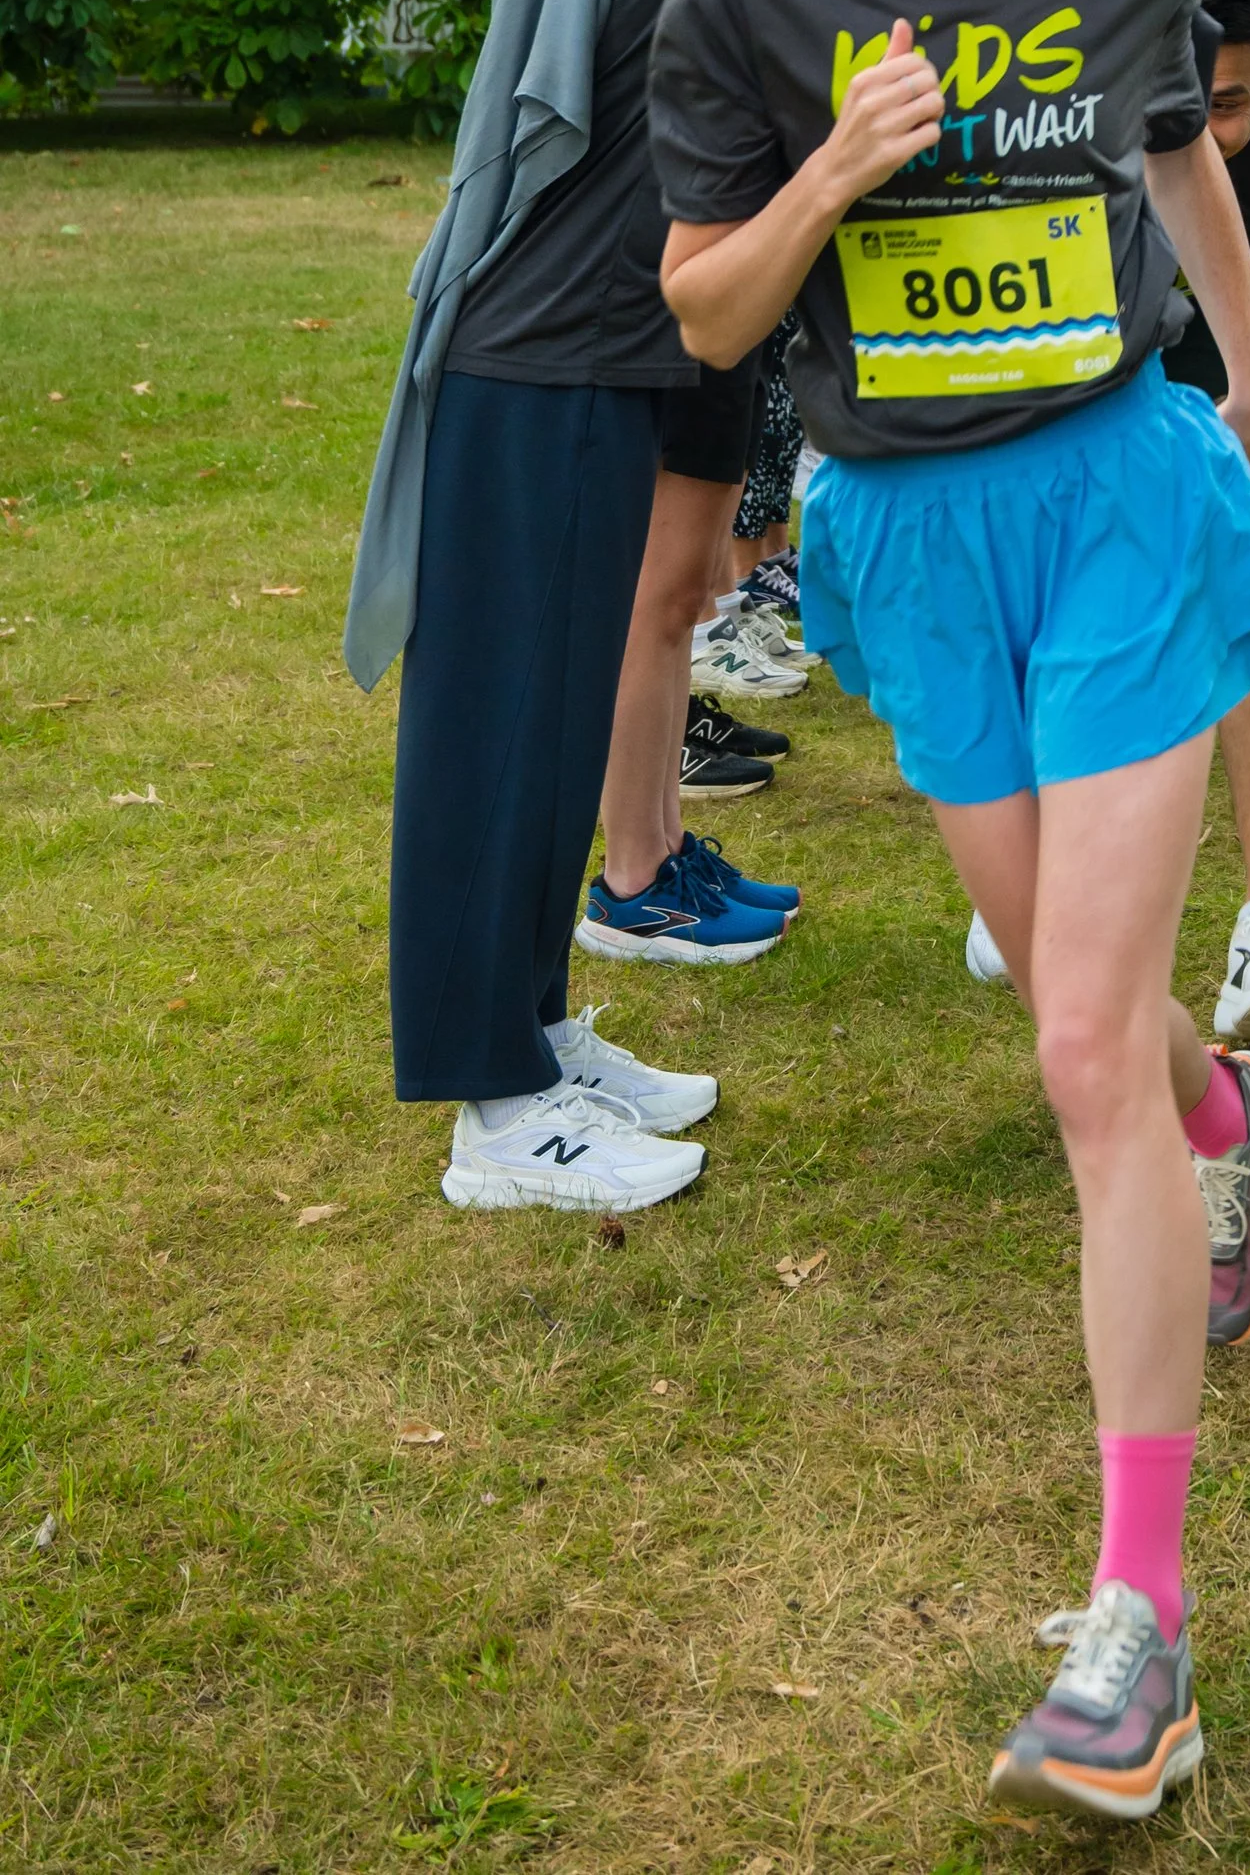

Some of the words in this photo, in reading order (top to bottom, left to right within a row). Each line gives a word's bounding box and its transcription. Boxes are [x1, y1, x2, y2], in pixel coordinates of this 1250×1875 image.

[1047, 214, 1083, 240] 5K
[902, 257, 1053, 320] 8061
[531, 1134, 592, 1166] N
